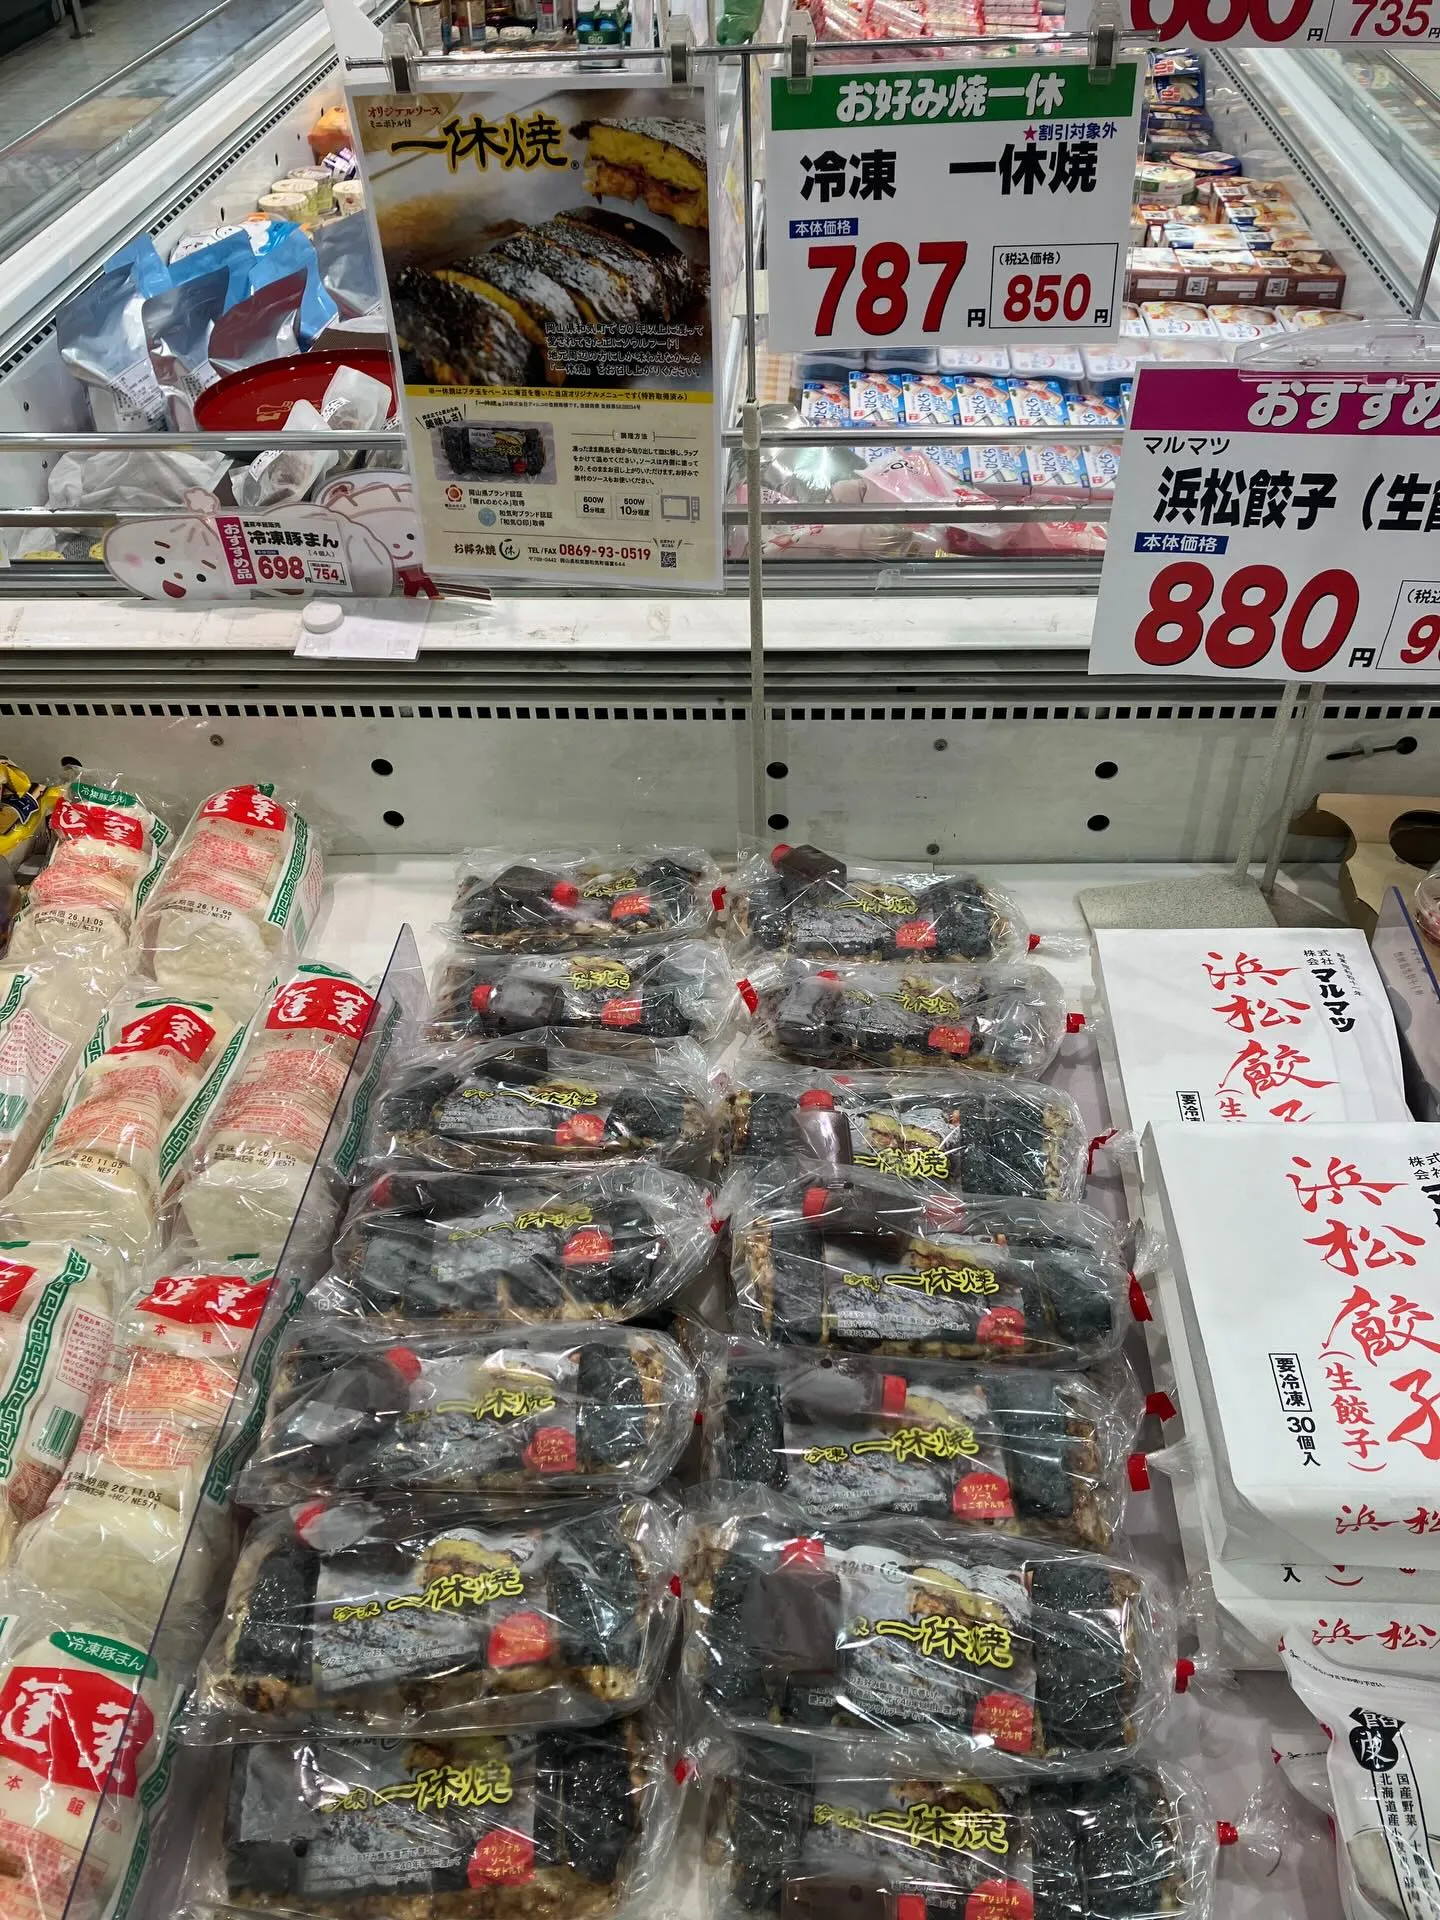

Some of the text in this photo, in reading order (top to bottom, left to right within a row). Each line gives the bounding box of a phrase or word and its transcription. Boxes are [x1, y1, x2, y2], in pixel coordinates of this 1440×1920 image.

[1307, 28, 1323, 41] 円
[1350, 0, 1433, 37] 735
[836, 72, 1066, 123] お好み焼一休
[800, 141, 1099, 202] 冷凍 一休焼
[795, 222, 852, 236] 本体価格
[807, 241, 986, 337] 787 円
[1003, 273, 1109, 323] 850 円
[1143, 436, 1230, 455] マルマツ
[223, 524, 253, 579] おすすめ品
[247, 530, 339, 548] 冷凍豚まん
[454, 543, 497, 556] お好み焼
[559, 544, 651, 561] 0869-93-0519
[1142, 535, 1218, 552] 本体価格
[258, 556, 305, 580] 698
[313, 568, 340, 580] 754
[1134, 561, 1376, 673] 880 円
[1311, 968, 1356, 1033] マルマツ
[1180, 1094, 1201, 1121] 要冷
[154, 1325, 167, 1336] 本
[1276, 1358, 1305, 1408] 要冷凍
[853, 1427, 980, 1463] 一休焼
[67, 1635, 144, 1671] 冷凍豚まん
[876, 1616, 1014, 1669] 一休焼
[5, 1775, 23, 1792] 本
[377, 1760, 513, 1811] 一休焼
[1397, 1773, 1418, 1827] 国産野菜
[868, 1804, 1009, 1853] 一休焼
